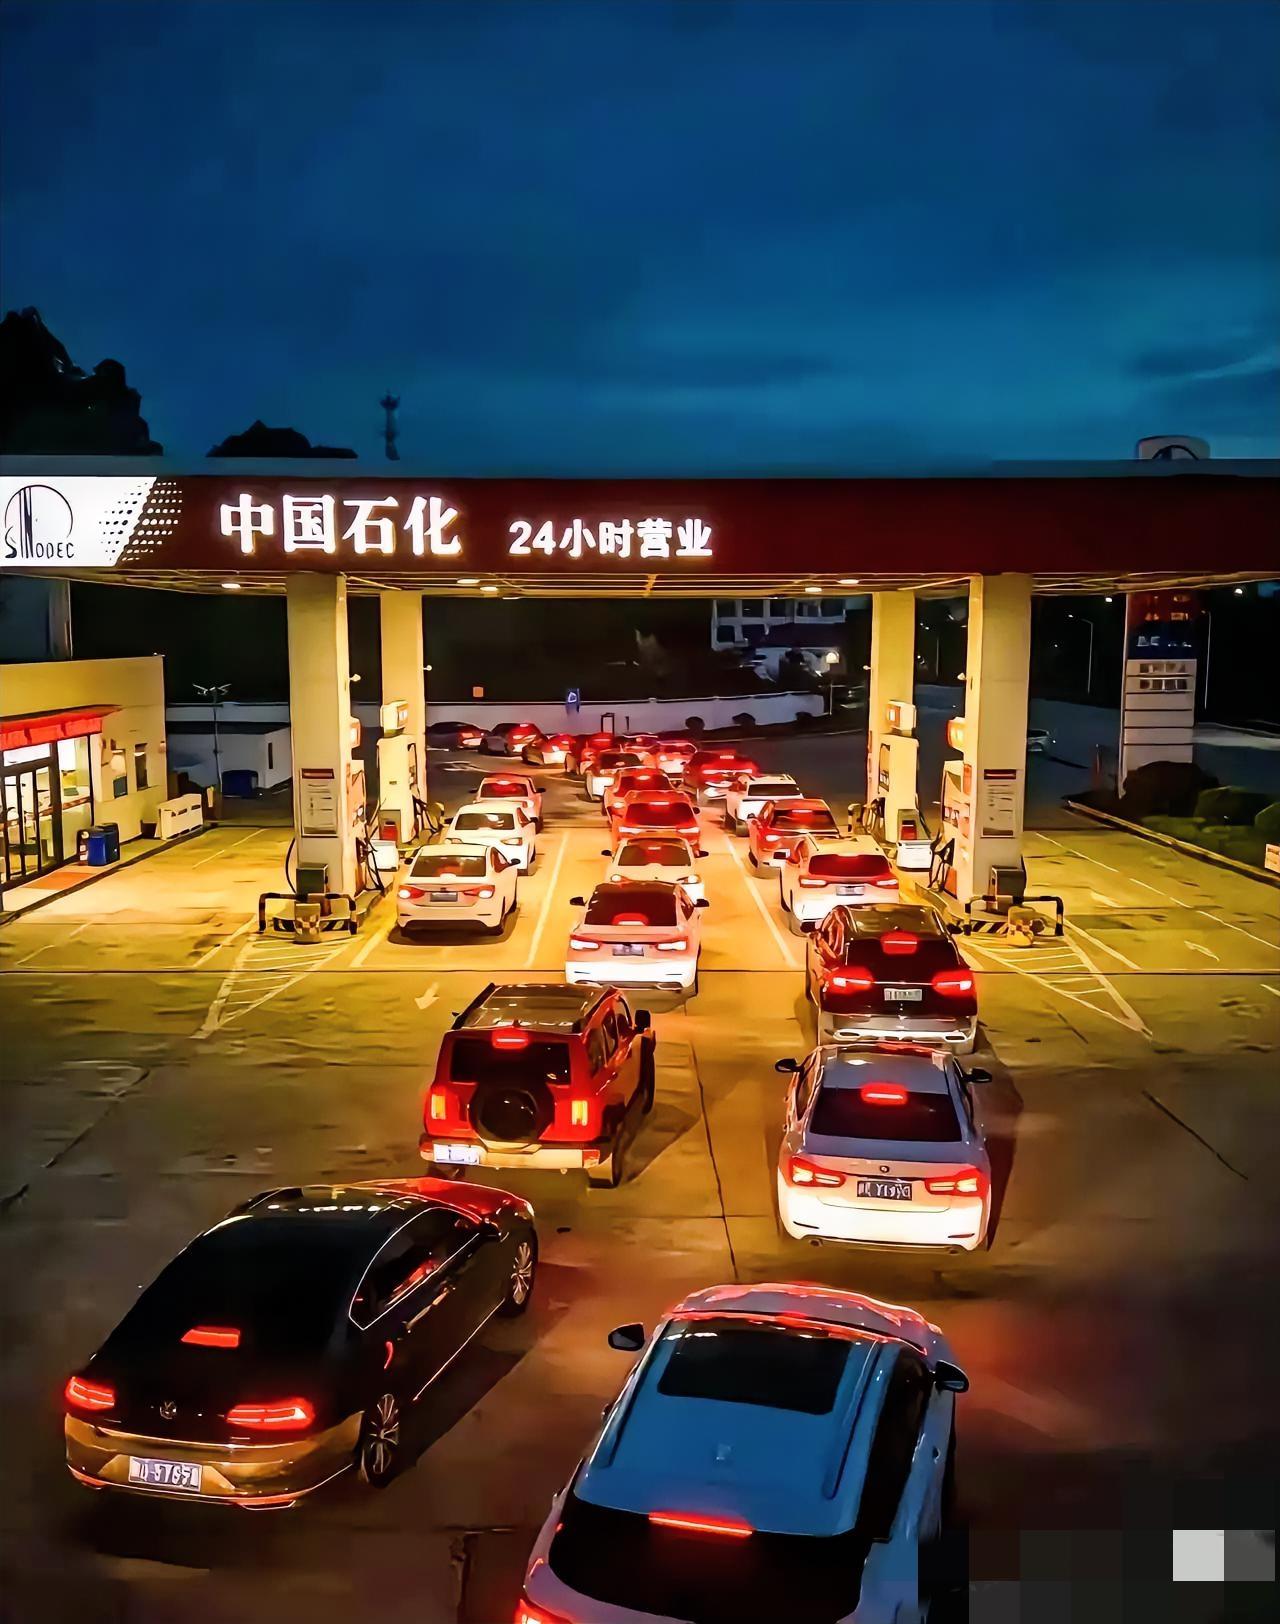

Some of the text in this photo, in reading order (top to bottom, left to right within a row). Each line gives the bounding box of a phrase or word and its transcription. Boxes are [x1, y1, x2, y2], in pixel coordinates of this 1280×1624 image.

[220, 494, 462, 556] 中国石化
[509, 518, 713, 559] 24小时营业
